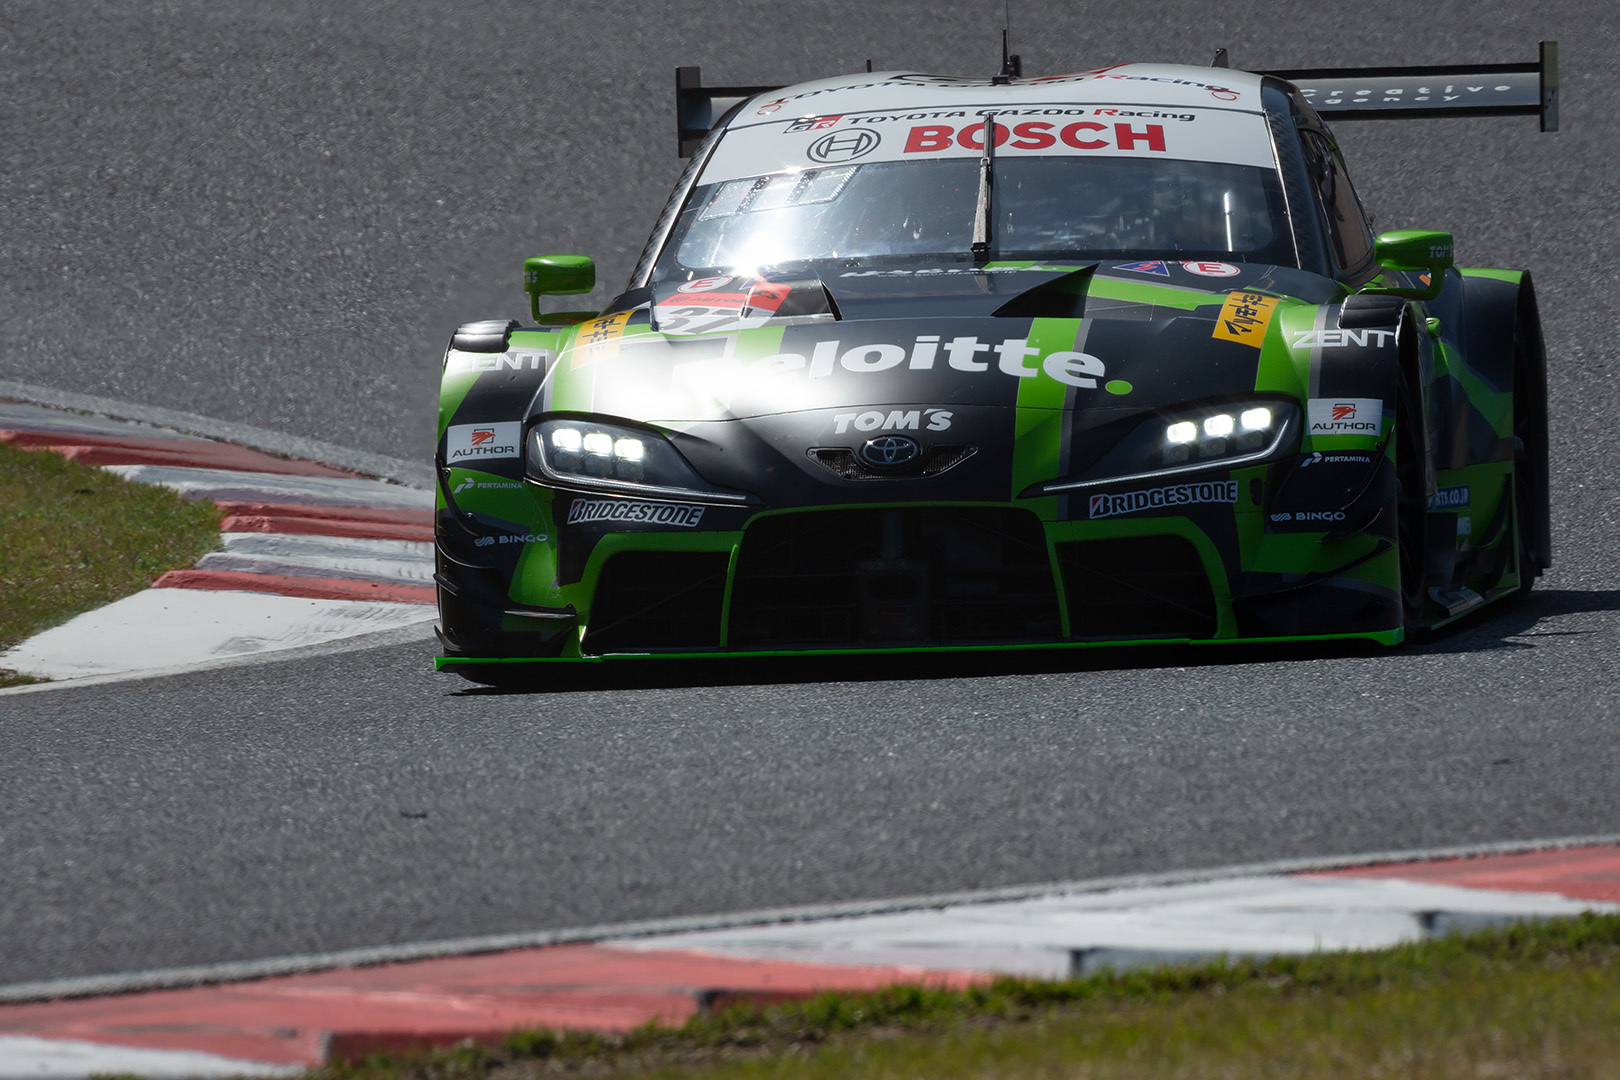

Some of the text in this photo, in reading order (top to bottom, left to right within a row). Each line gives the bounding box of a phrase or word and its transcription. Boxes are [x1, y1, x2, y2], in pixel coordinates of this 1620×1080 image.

[1094, 74, 1230, 92] Racing
[1299, 84, 1512, 97] Creative
[847, 111, 966, 125] TOYOTA
[975, 109, 1085, 117] GAZOO
[1092, 108, 1196, 122] Racing
[903, 121, 1167, 153] BOSCH
[656, 307, 753, 335] 37
[1292, 329, 1395, 349] ZENT
[832, 408, 954, 435] TOM'S
[1312, 422, 1377, 431] AUTHOR
[452, 446, 515, 458] AUTHOR
[1324, 455, 1371, 464] PERTAMINA
[477, 482, 523, 490] PERTAMINA
[1090, 481, 1238, 519] BRIDGESTONE
[567, 500, 704, 527] BRIDGESTONE
[1295, 511, 1346, 523] BINGO
[499, 533, 548, 544] BINGO
